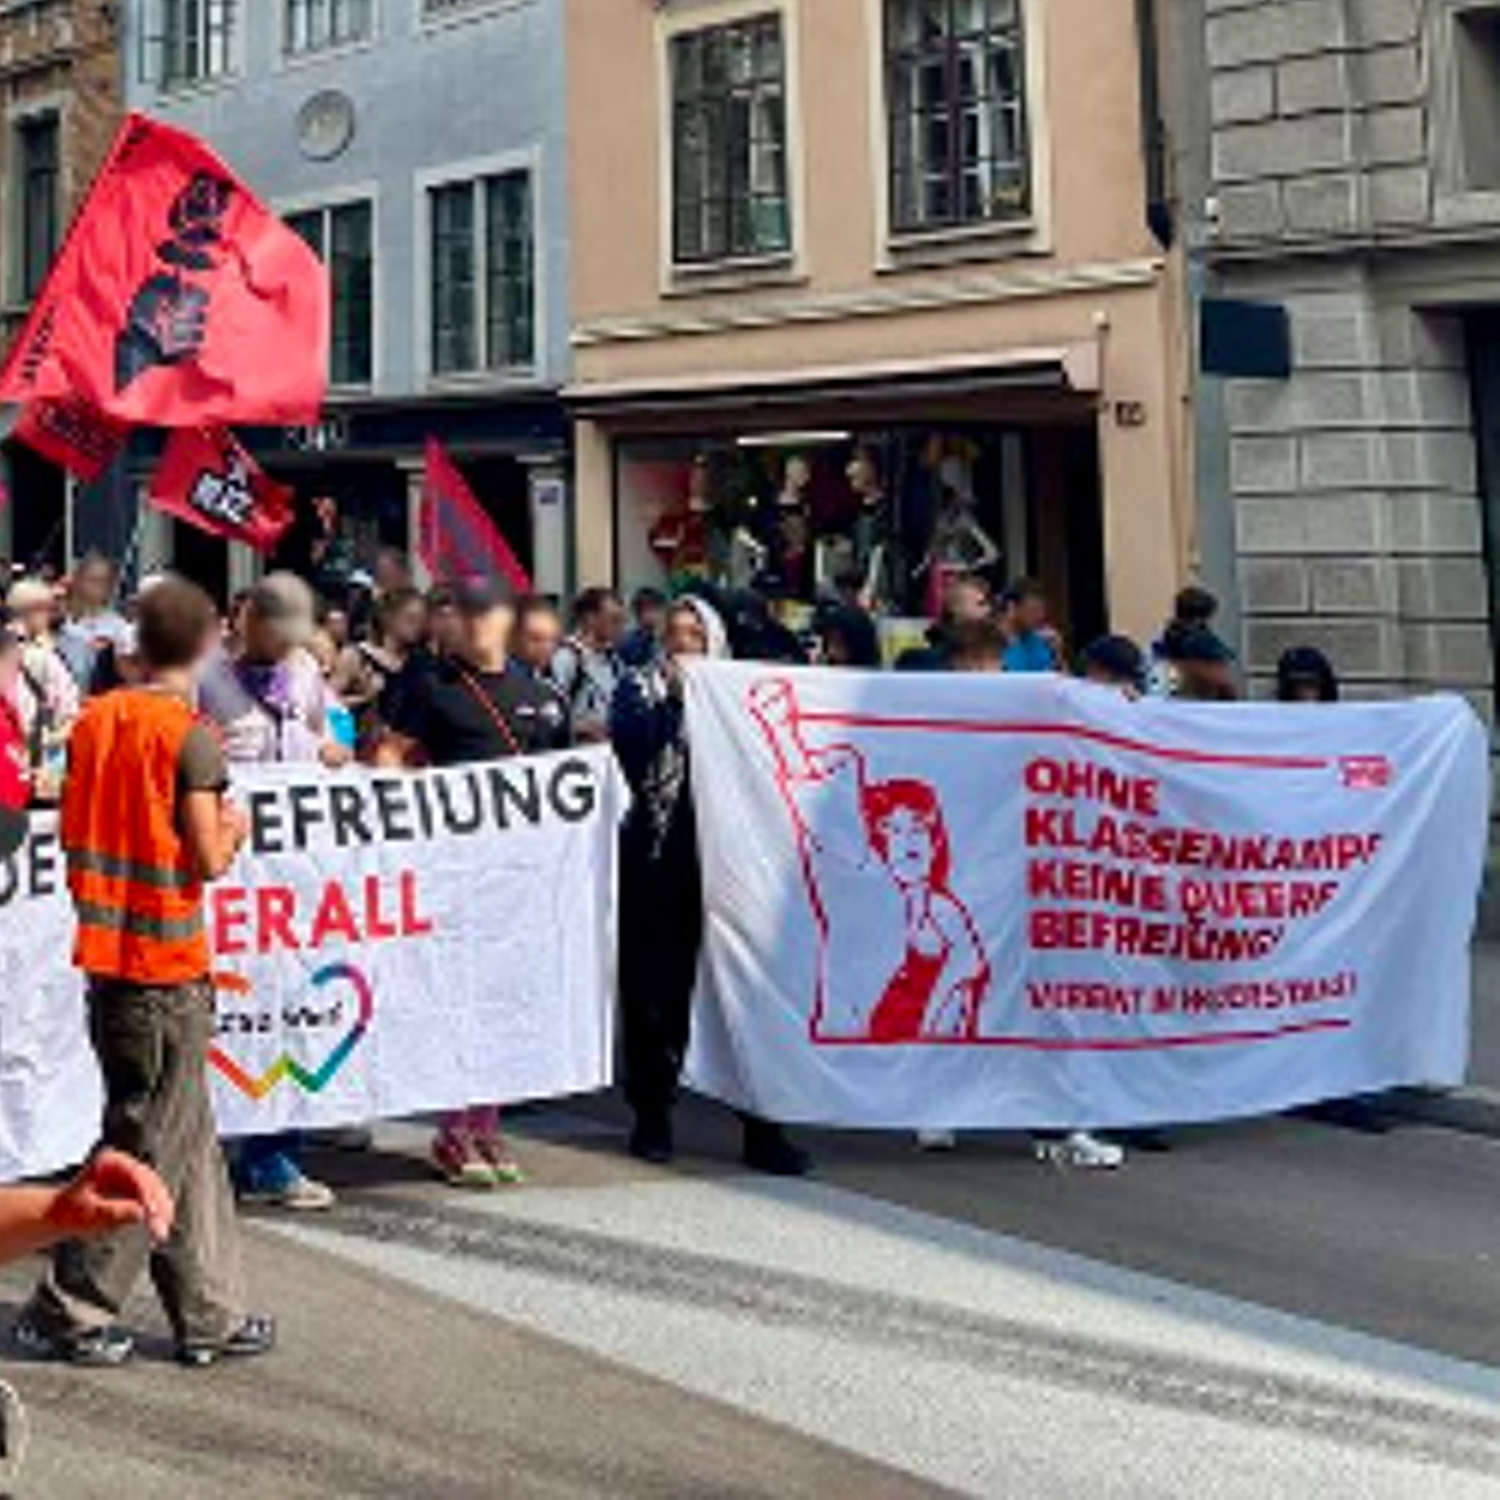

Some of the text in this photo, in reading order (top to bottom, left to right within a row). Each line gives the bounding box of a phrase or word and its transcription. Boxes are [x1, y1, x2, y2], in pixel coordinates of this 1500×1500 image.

[251, 760, 596, 854] EFREIUNG
[1025, 758, 1158, 817] OHNE
[211, 871, 434, 955] ERALL
[1027, 860, 1167, 912] KEINE
